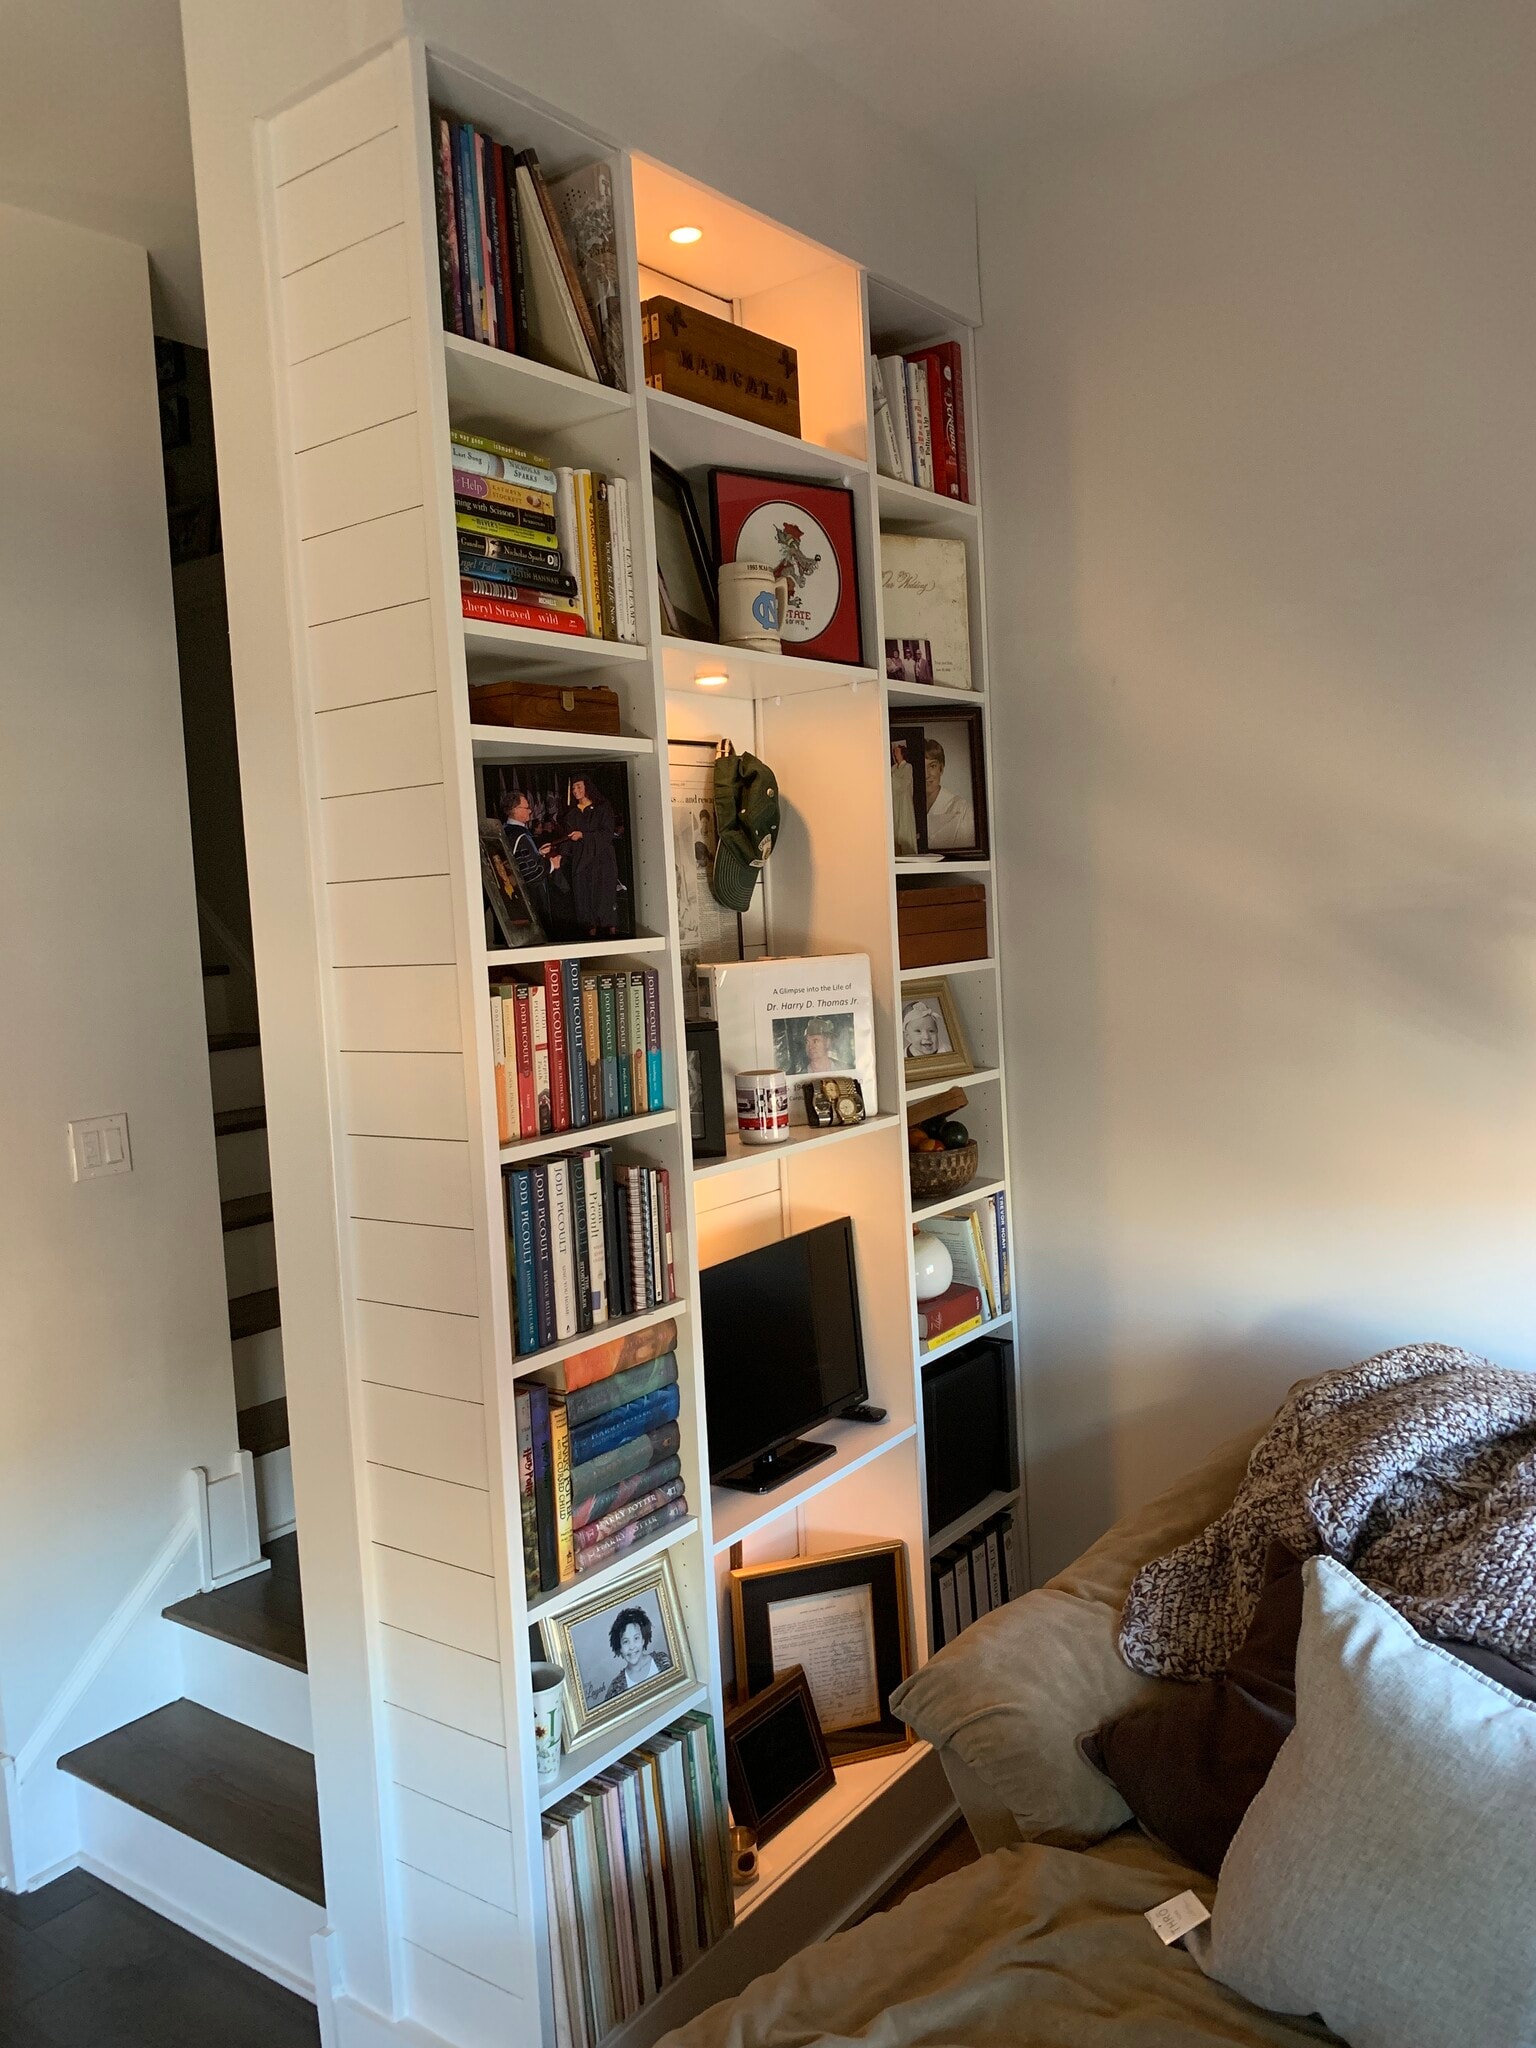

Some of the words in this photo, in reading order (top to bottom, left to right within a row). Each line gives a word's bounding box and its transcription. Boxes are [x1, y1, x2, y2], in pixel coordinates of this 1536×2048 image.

[492, 226, 501, 247] High
[493, 246, 503, 274] School
[679, 350, 789, 405] MANCALA
[459, 433, 470, 442] way
[471, 437, 484, 446] gone
[452, 447, 466, 459] Last
[467, 451, 483, 465] Song
[507, 460, 541, 476] NICHOLAS
[461, 476, 484, 495] Help
[513, 470, 538, 483] SPARKS
[455, 498, 472, 511] ning
[472, 500, 488, 513] with
[489, 504, 516, 519] Scissors
[459, 557, 478, 572] ngel
[589, 508, 599, 558] STACKING
[595, 579, 603, 607] DECK
[626, 548, 634, 579] TEAM
[472, 578, 519, 601] UNLIMITED
[532, 571, 561, 585] HANNAH
[608, 585, 617, 603] Life
[628, 589, 637, 627] TEAMS
[495, 603, 531, 623] Strayed
[538, 613, 560, 625] wild
[685, 794, 698, 804] and
[549, 967, 559, 998] JODI
[569, 961, 579, 991] JODI
[648, 975, 656, 1000] JODI
[586, 994, 594, 1014] JODI
[604, 992, 612, 1013] JODI
[633, 989, 641, 1009] JODI
[766, 1003, 780, 1011] Dr.
[781, 1001, 805, 1011] Harry
[806, 1000, 816, 1009] D.
[817, 998, 849, 1008] Thomas
[850, 997, 860, 1006] Jr.
[779, 987, 806, 997] Glimpse
[806, 986, 820, 994] into
[519, 1002, 528, 1022] JODI
[552, 999, 563, 1054] PICOULT
[572, 994, 584, 1050] PICOULT
[649, 1001, 658, 1045] PICOULT
[588, 1014, 597, 1053] PICOULT
[605, 1014, 613, 1052] PICOULT
[619, 1013, 627, 1050] PICOULT
[634, 1009, 643, 1047] PICOULT
[521, 1023, 530, 1066] PICOULT
[536, 1059, 544, 1081] Faith
[579, 1083, 587, 1113] MINUTES
[518, 1174, 529, 1206] JODI
[534, 1172, 546, 1203] JODI
[553, 1167, 564, 1197] JODI
[573, 1160, 585, 1195] JODI
[556, 1200, 567, 1255] PICOULT
[576, 1196, 590, 1257] PICOULT
[589, 1191, 600, 1240] Picoult
[522, 1210, 533, 1266] PICOULT
[537, 1206, 549, 1262] PICOULT
[579, 1260, 588, 1309] STORYTELLER
[528, 1314, 536, 1336] CARE
[522, 1447, 533, 1473] Harry
[561, 1434, 572, 1473] HARRY
[525, 1470, 536, 1498] Potter
[557, 1462, 565, 1493] CURSED
[559, 1494, 567, 1520] CHILD
[564, 1473, 573, 1521] POTTER
[596, 1508, 627, 1531] HARRY
[627, 1494, 658, 1514] POTTER
[596, 1532, 626, 1553] HARRY
[629, 1514, 659, 1535] OTTER
